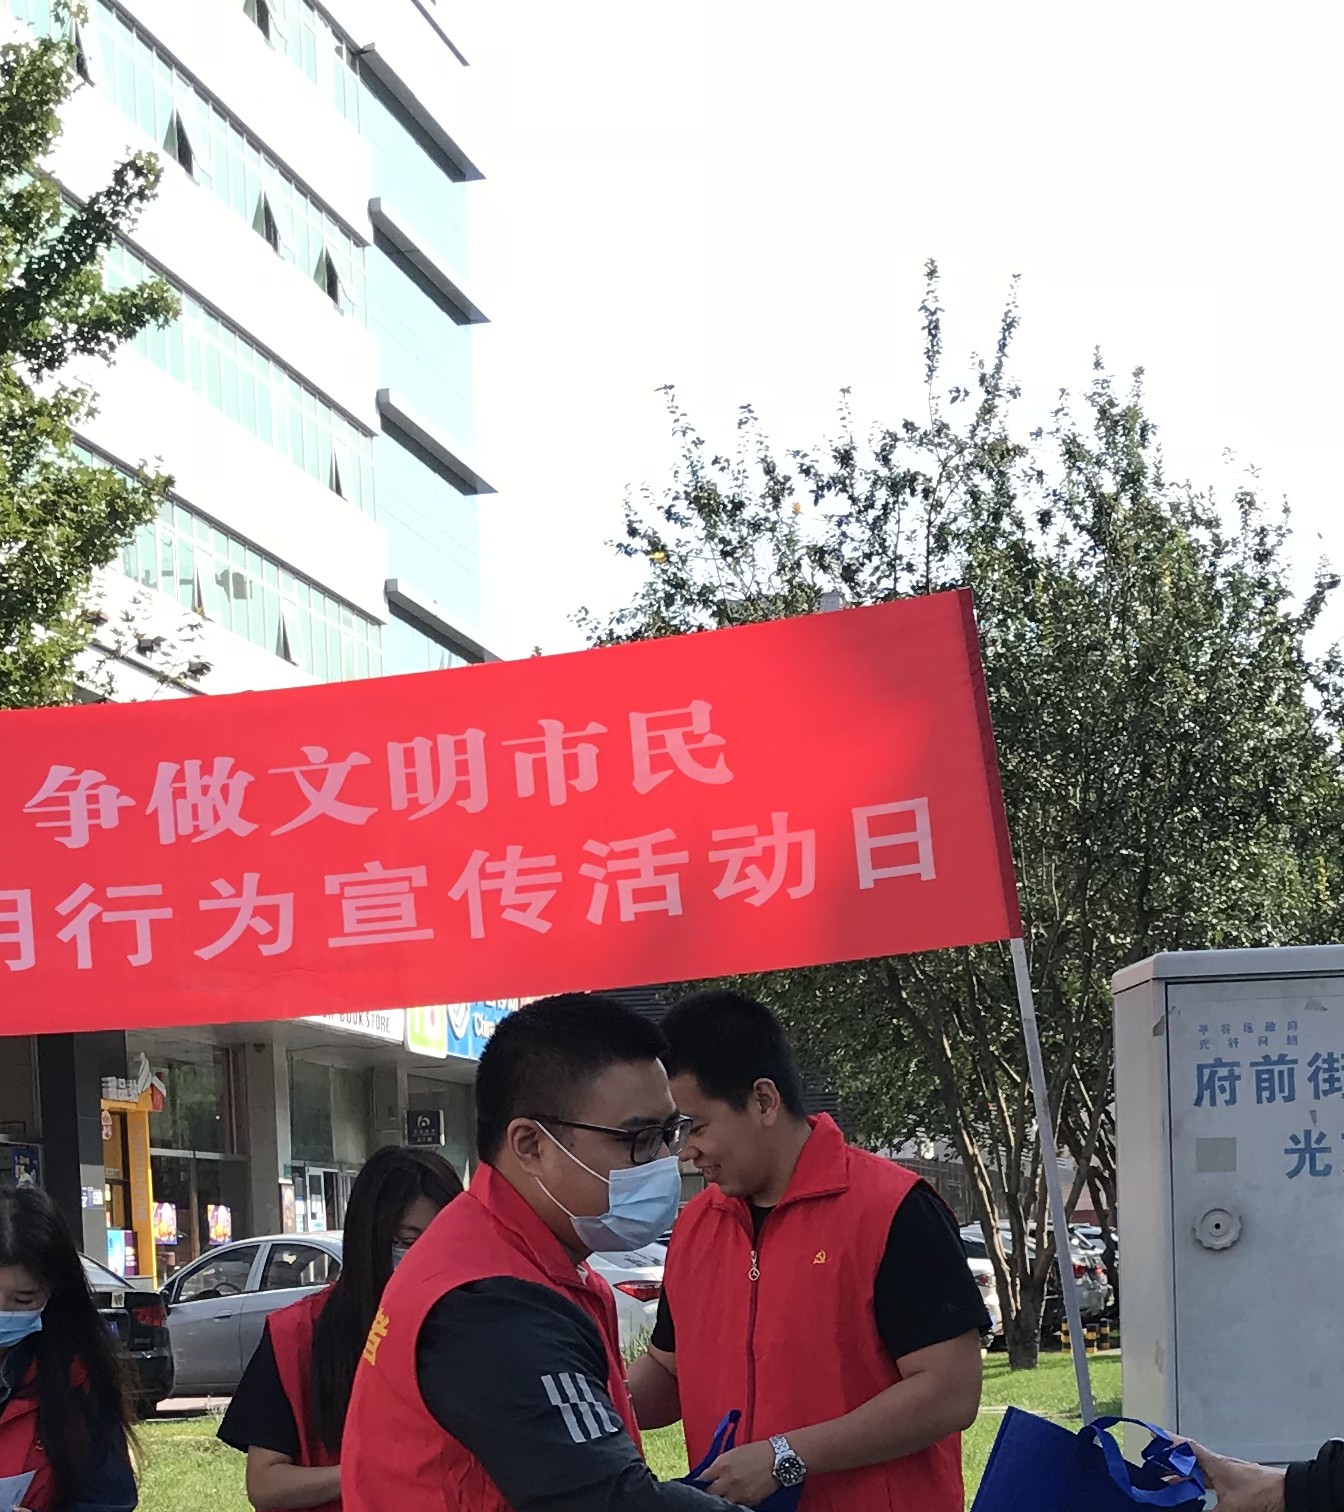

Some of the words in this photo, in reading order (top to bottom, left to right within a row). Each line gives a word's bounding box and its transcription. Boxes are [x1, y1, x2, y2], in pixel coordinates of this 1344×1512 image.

[23, 699, 733, 850] 争做文明市民
